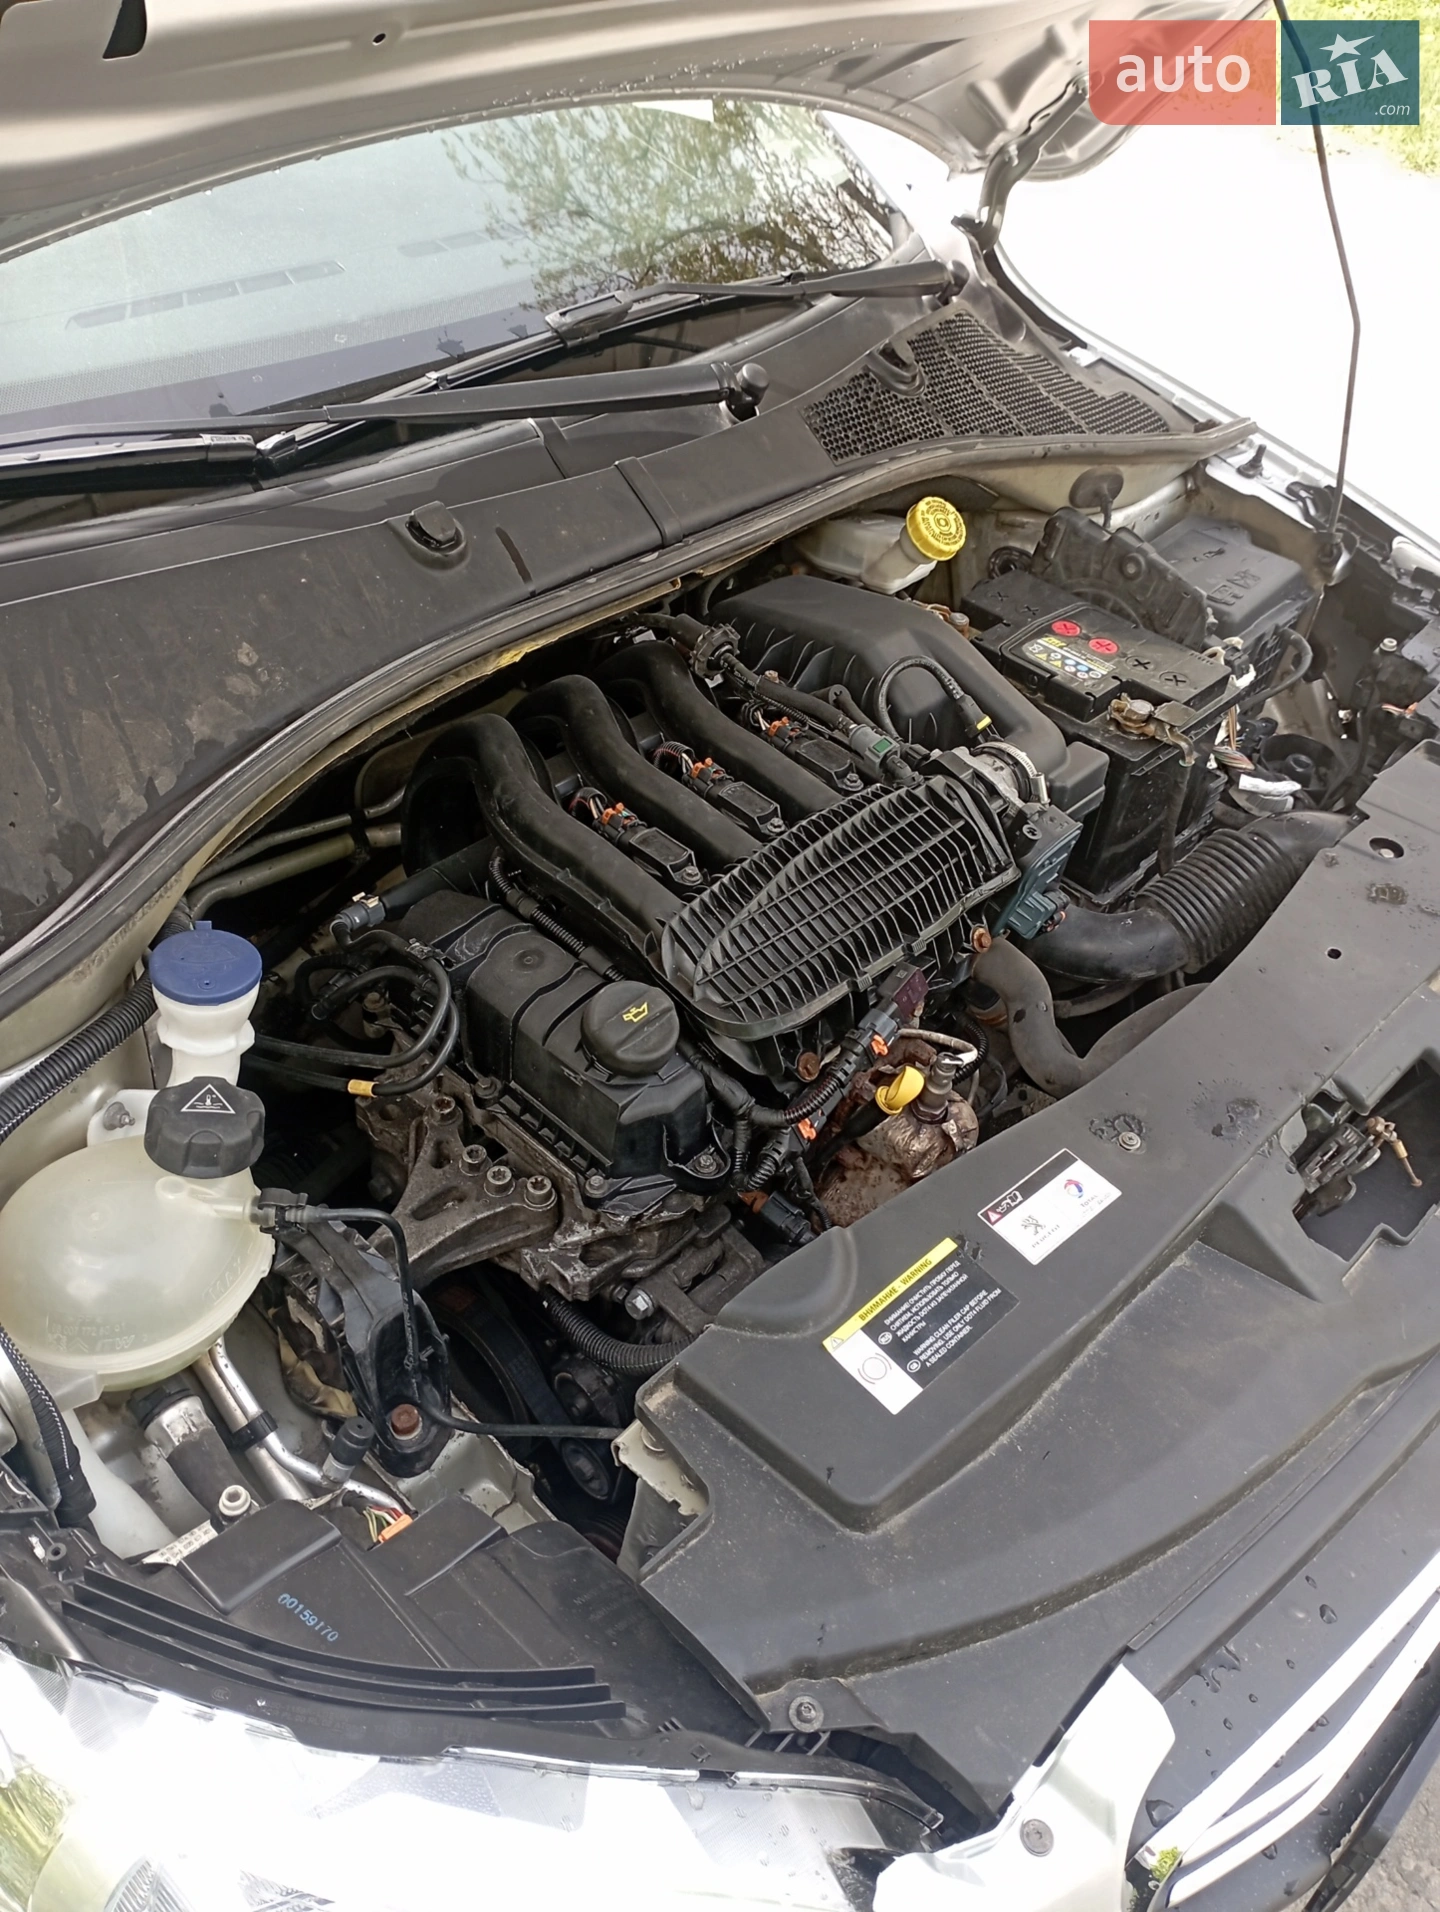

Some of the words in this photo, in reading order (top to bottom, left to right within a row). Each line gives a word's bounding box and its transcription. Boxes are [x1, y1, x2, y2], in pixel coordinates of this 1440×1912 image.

[1079, 1192, 1098, 1208] TOTAL
[944, 1259, 961, 1274] ПЕРЕД
[858, 1286, 899, 1321] ВНИМАНИЕ
[900, 1257, 932, 1285] WARNING
[941, 1270, 959, 1287] ТОЛЬКО
[929, 1299, 937, 1307] ИЗ
[942, 1329, 954, 1340] USE
[951, 1319, 966, 1332] ONLY
[963, 1308, 977, 1322] DOT4
[974, 1298, 989, 1312] FLUID
[986, 1287, 1002, 1301] FROM
[901, 1320, 926, 1343] КАНИСТРЫ
[912, 1334, 936, 1356] WARNING
[933, 1322, 950, 1338] CLEAN
[959, 1303, 971, 1315] CAP
[968, 1289, 988, 1307] BEFORE
[928, 1345, 947, 1364] SEALED
[278, 1593, 339, 1642] 00159170
